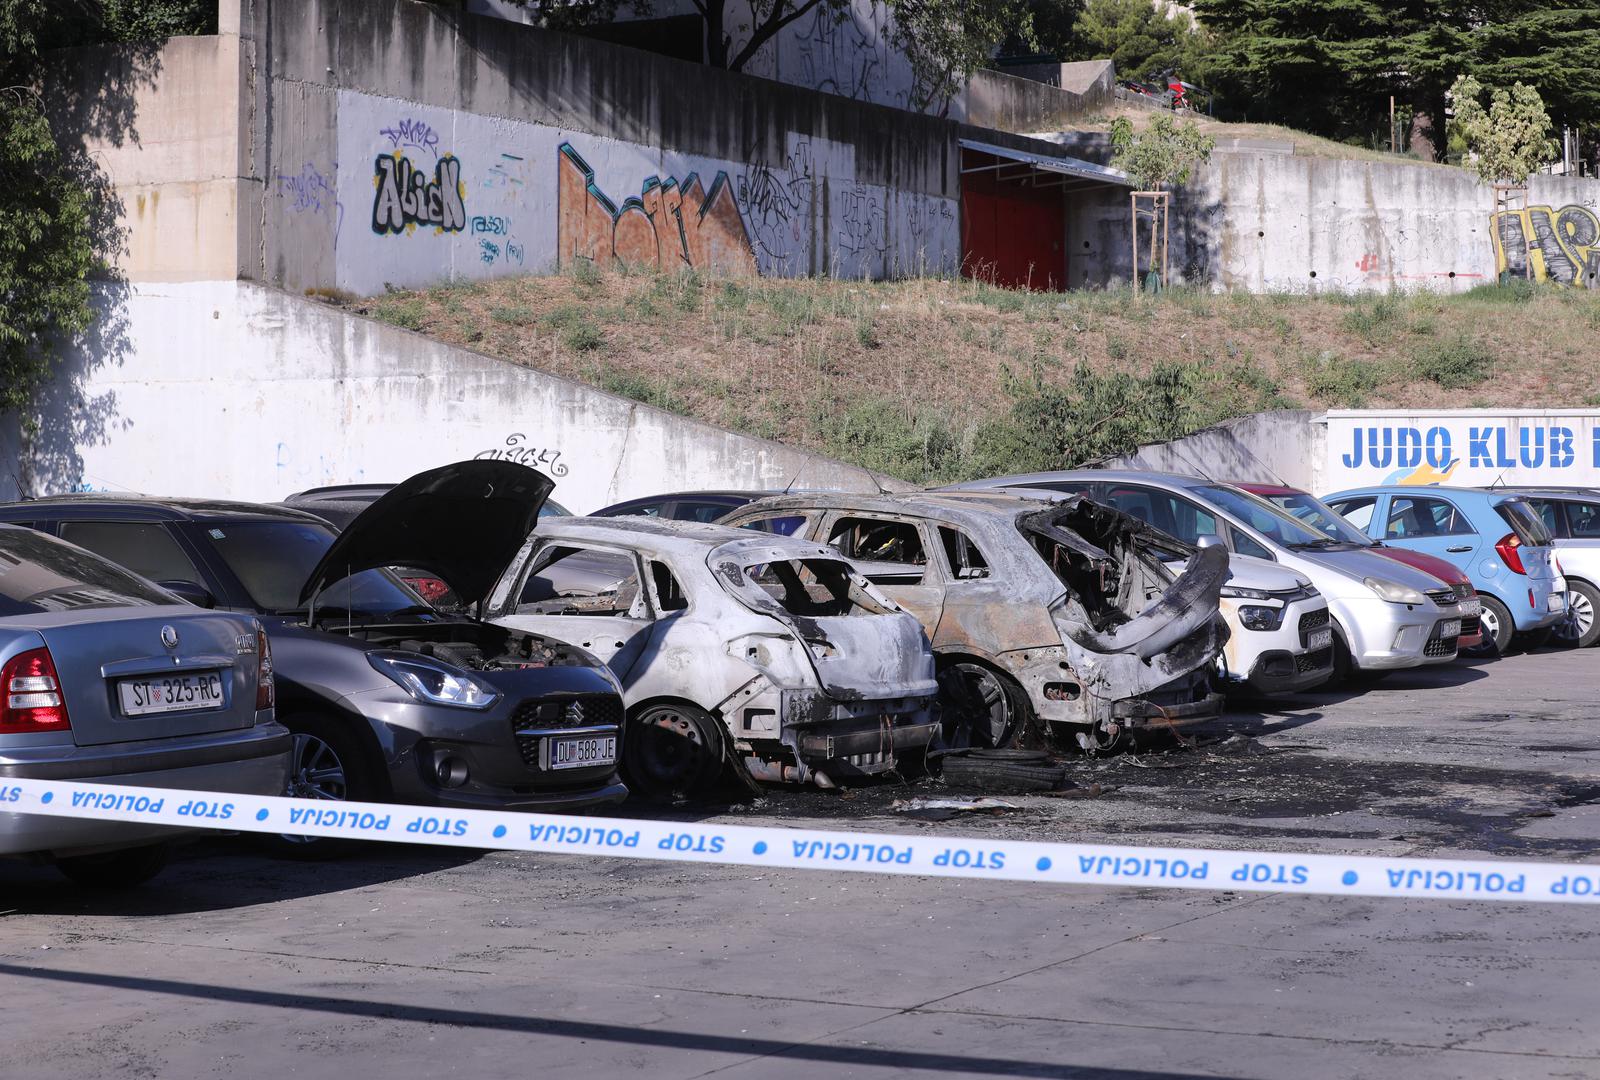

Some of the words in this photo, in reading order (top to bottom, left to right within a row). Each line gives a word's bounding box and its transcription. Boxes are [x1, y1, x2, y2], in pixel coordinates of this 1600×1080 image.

[1342, 426, 1452, 469] JUDO
[1469, 426, 1575, 469] KLUB
[133, 681, 151, 706] ST
[163, 676, 220, 703] 325-RC
[558, 742, 571, 762] DU
[0, 786, 22, 802] ST
[72, 791, 164, 814] POLICIJA
[177, 800, 235, 819] STOP
[290, 808, 391, 831] POLICIJA
[406, 817, 469, 836] STOP
[529, 824, 640, 848] POLICIJA
[658, 833, 726, 853] STOP
[792, 840, 913, 864] POLICIJA
[932, 848, 1006, 870] STOP
[1078, 855, 1208, 880] POLICIJA
[1231, 863, 1309, 885] STOP
[1387, 868, 1525, 893] POLICIJA
[1550, 875, 1600, 896] OP
